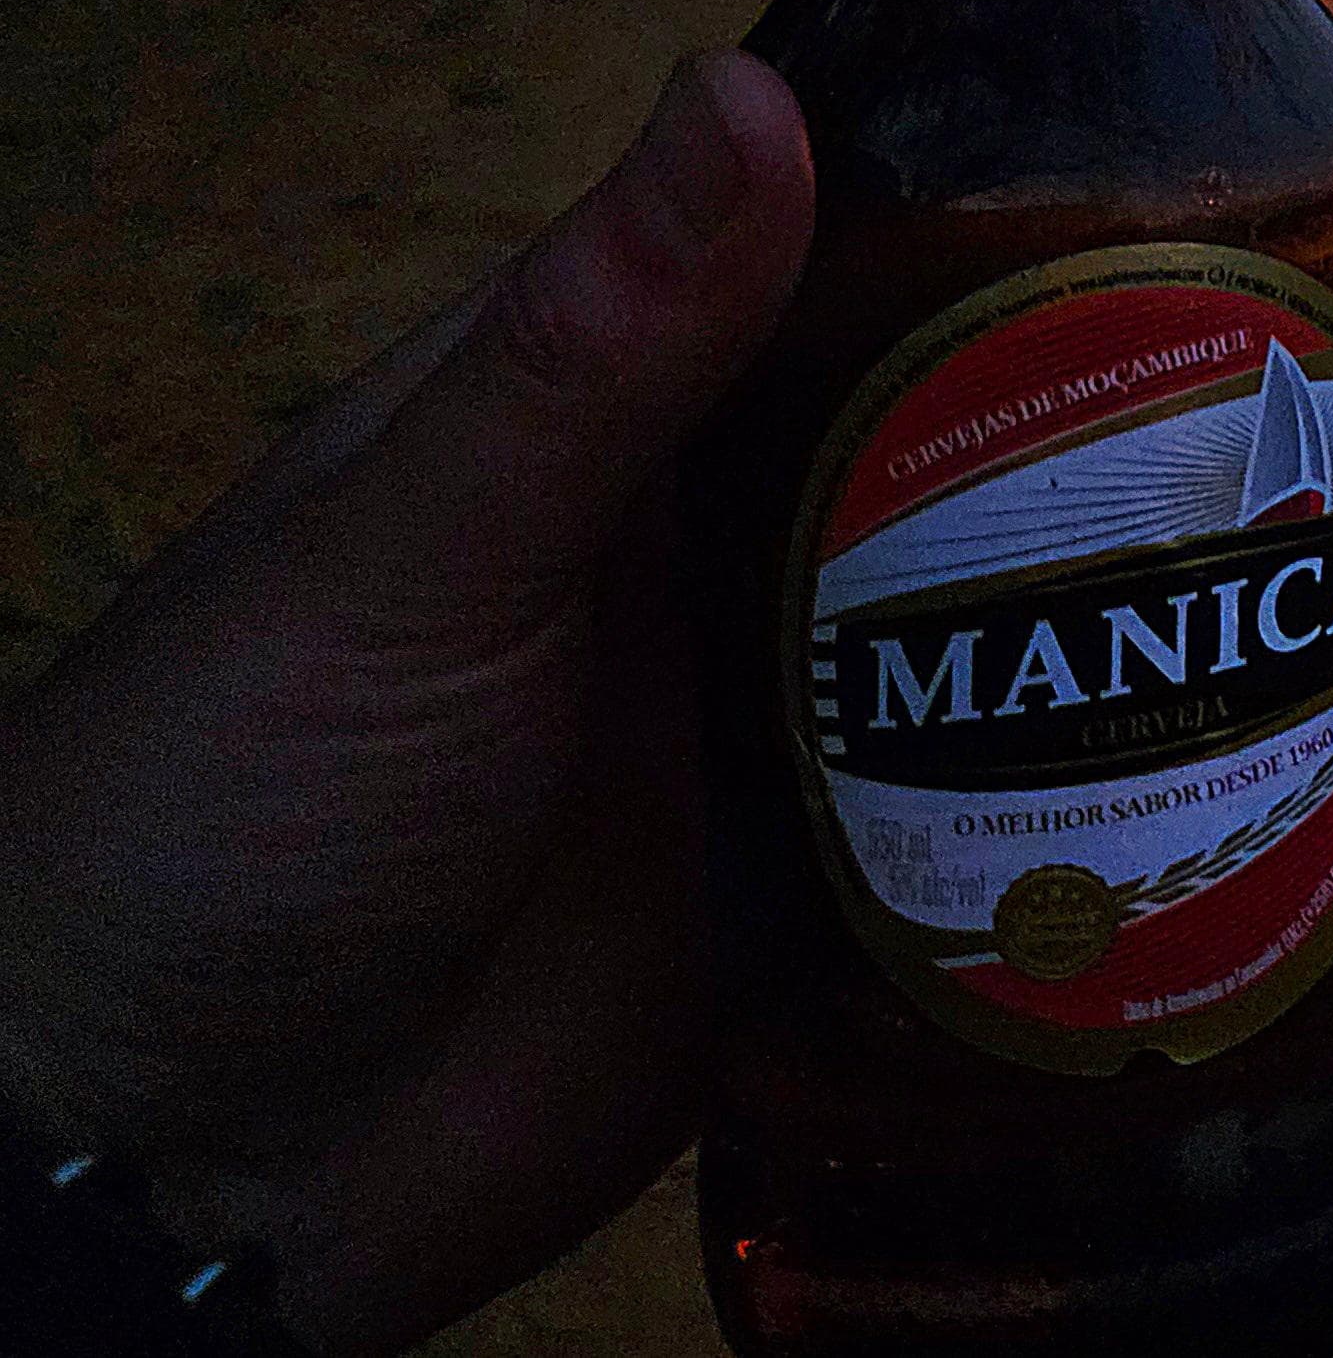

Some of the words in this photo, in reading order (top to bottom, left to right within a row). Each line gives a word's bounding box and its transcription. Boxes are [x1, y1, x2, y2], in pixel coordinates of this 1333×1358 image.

[886, 402, 1018, 482] CERVEJAS
[1018, 391, 1057, 422] DE
[1060, 328, 1255, 408] MOÇAMBIQUE
[1081, 694, 1231, 748] CERVEJA
[952, 814, 977, 837] O
[980, 802, 1105, 837] MELHOR
[1108, 783, 1203, 822] SABOR
[1206, 753, 1286, 801] DESDE
